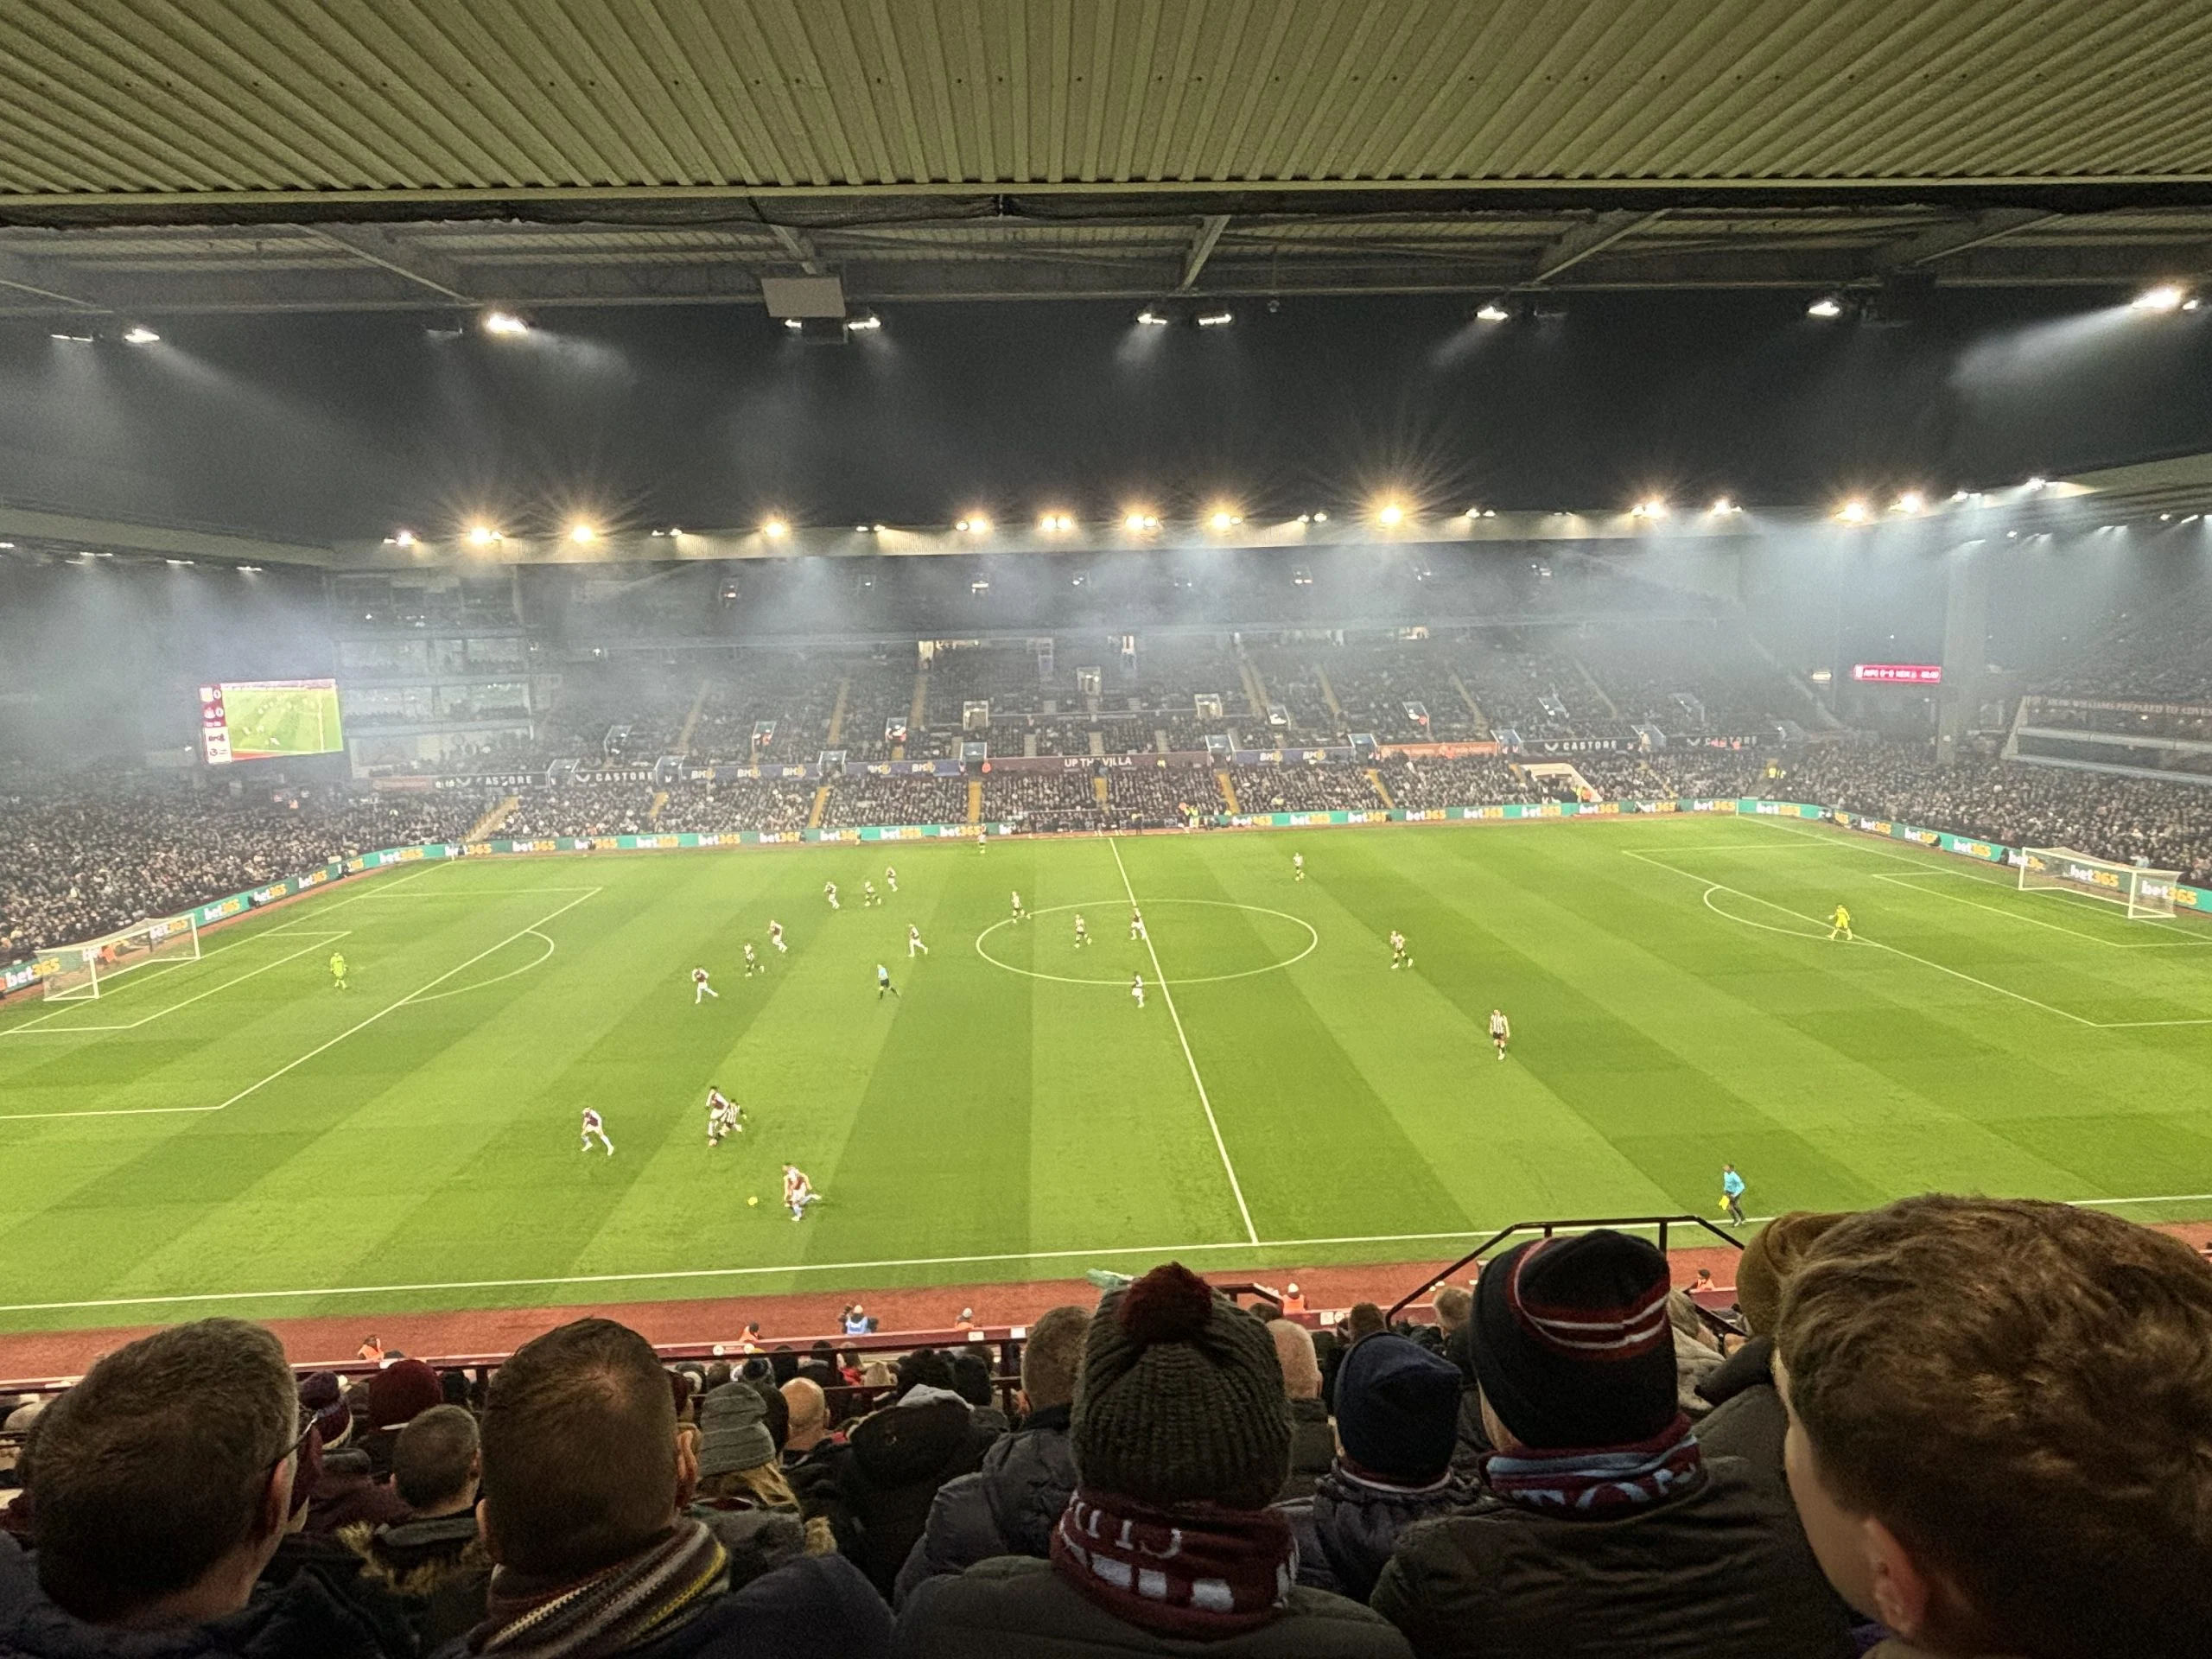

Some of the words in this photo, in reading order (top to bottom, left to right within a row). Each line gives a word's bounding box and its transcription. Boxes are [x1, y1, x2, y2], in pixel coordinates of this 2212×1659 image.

[1563, 741, 1617, 750] CASTORE
[1065, 759, 1078, 767] UP
[1103, 757, 1132, 767] VILLA
[595, 772, 653, 782] CASTORE
[1580, 804, 1618, 814] bet365
[1694, 799, 1736, 810] bet365
[1757, 802, 1800, 816] bet365
[1406, 810, 1446, 821] bet365
[1464, 808, 1503, 818] bet365
[1522, 805, 1560, 817] bet365
[1290, 814, 1330, 825] bet365
[1861, 817, 1891, 835] bet365
[698, 834, 741, 845] bet365
[880, 828, 922, 840] bet365
[512, 841, 556, 852] bet365
[636, 836, 678, 848] bet365
[1954, 838, 1991, 857] bet365
[380, 849, 423, 864] bet365
[299, 870, 327, 888] bet365
[2070, 865, 2119, 887] bet365
[253, 883, 286, 902] bet365
[2142, 880, 2197, 906] bet365
[204, 899, 239, 920] bet365
[5, 957, 60, 988] bet365
